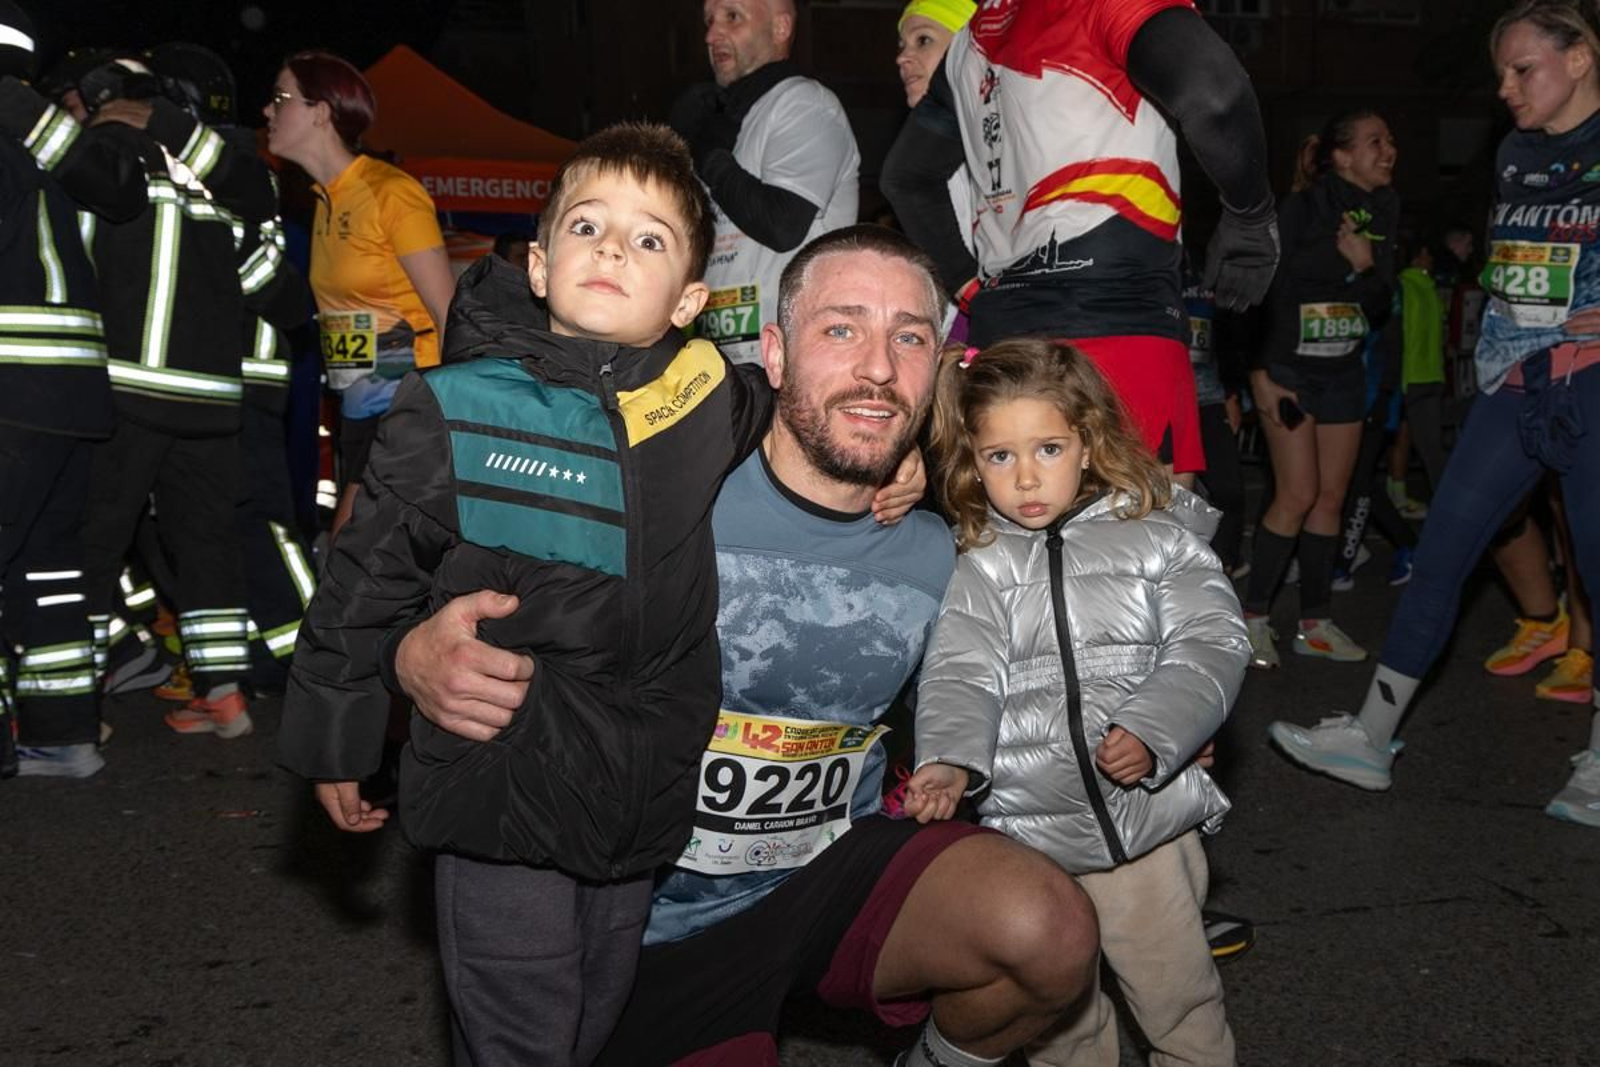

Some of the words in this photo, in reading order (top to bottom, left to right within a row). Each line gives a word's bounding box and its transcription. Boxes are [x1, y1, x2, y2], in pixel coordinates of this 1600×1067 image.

[1308, 317, 1364, 338] 1894
[671, 370, 713, 409] COMPETITION
[742, 722, 783, 754] 42
[702, 758, 849, 816] 9220
[734, 821, 762, 831] DANIEL
